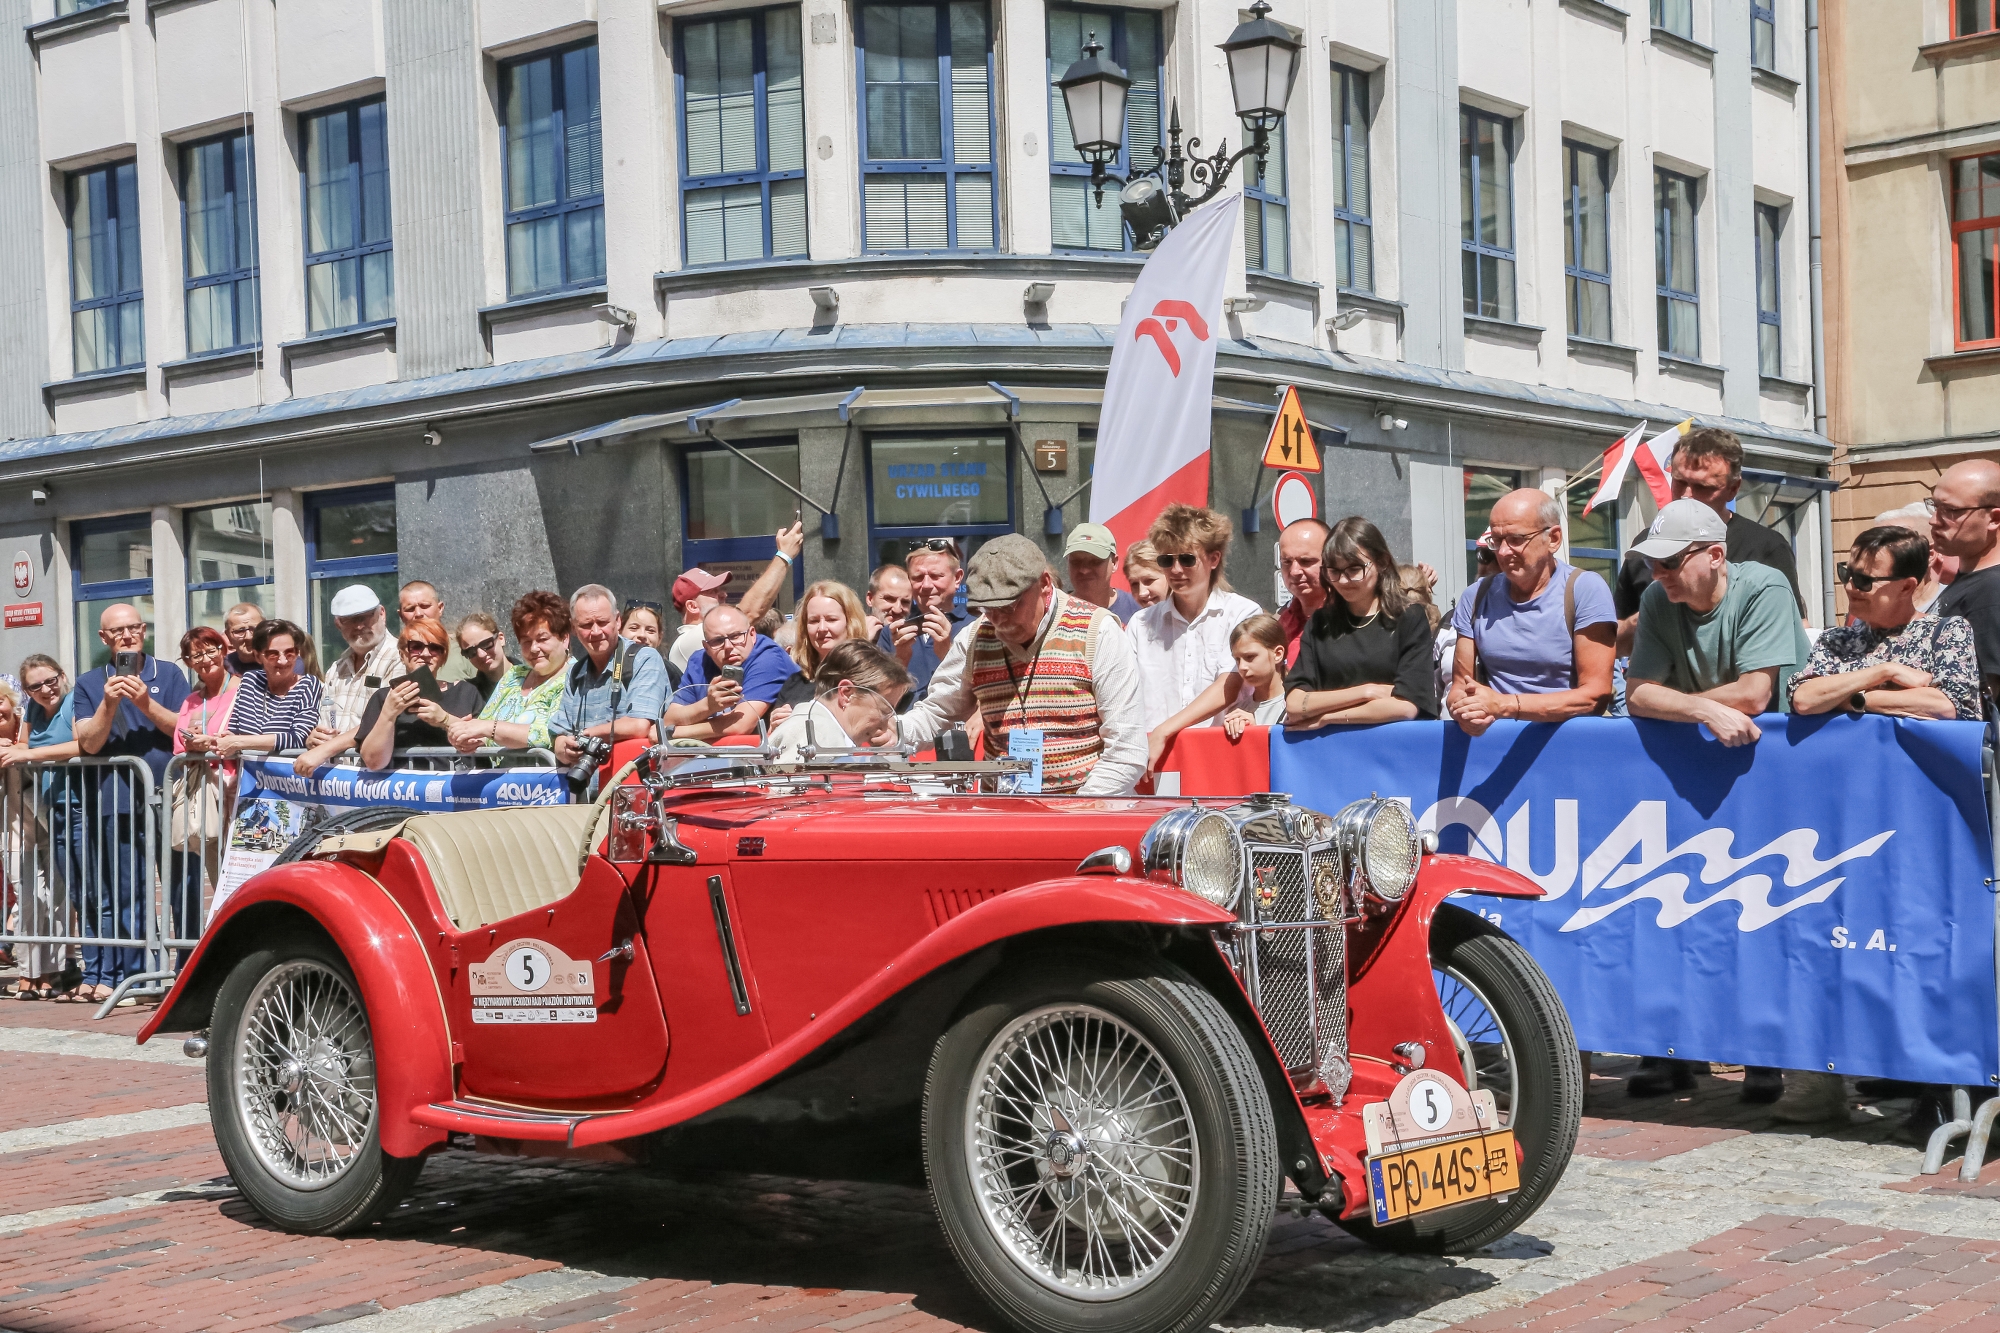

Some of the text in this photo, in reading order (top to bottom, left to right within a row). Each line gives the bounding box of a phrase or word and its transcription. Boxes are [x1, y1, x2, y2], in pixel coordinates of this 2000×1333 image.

[1047, 451, 1057, 469] 5
[888, 462, 988, 481] URZĄD STANU
[895, 482, 981, 499] CYWILNEGO
[255, 769, 420, 802] Skorzystaj z usług AQUA S.A.
[495, 783, 548, 803] AQUA
[523, 954, 535, 985] 5
[1425, 1089, 1438, 1124] 5
[1388, 1147, 1477, 1212] PO 44S
[1376, 1198, 1387, 1213] PL
